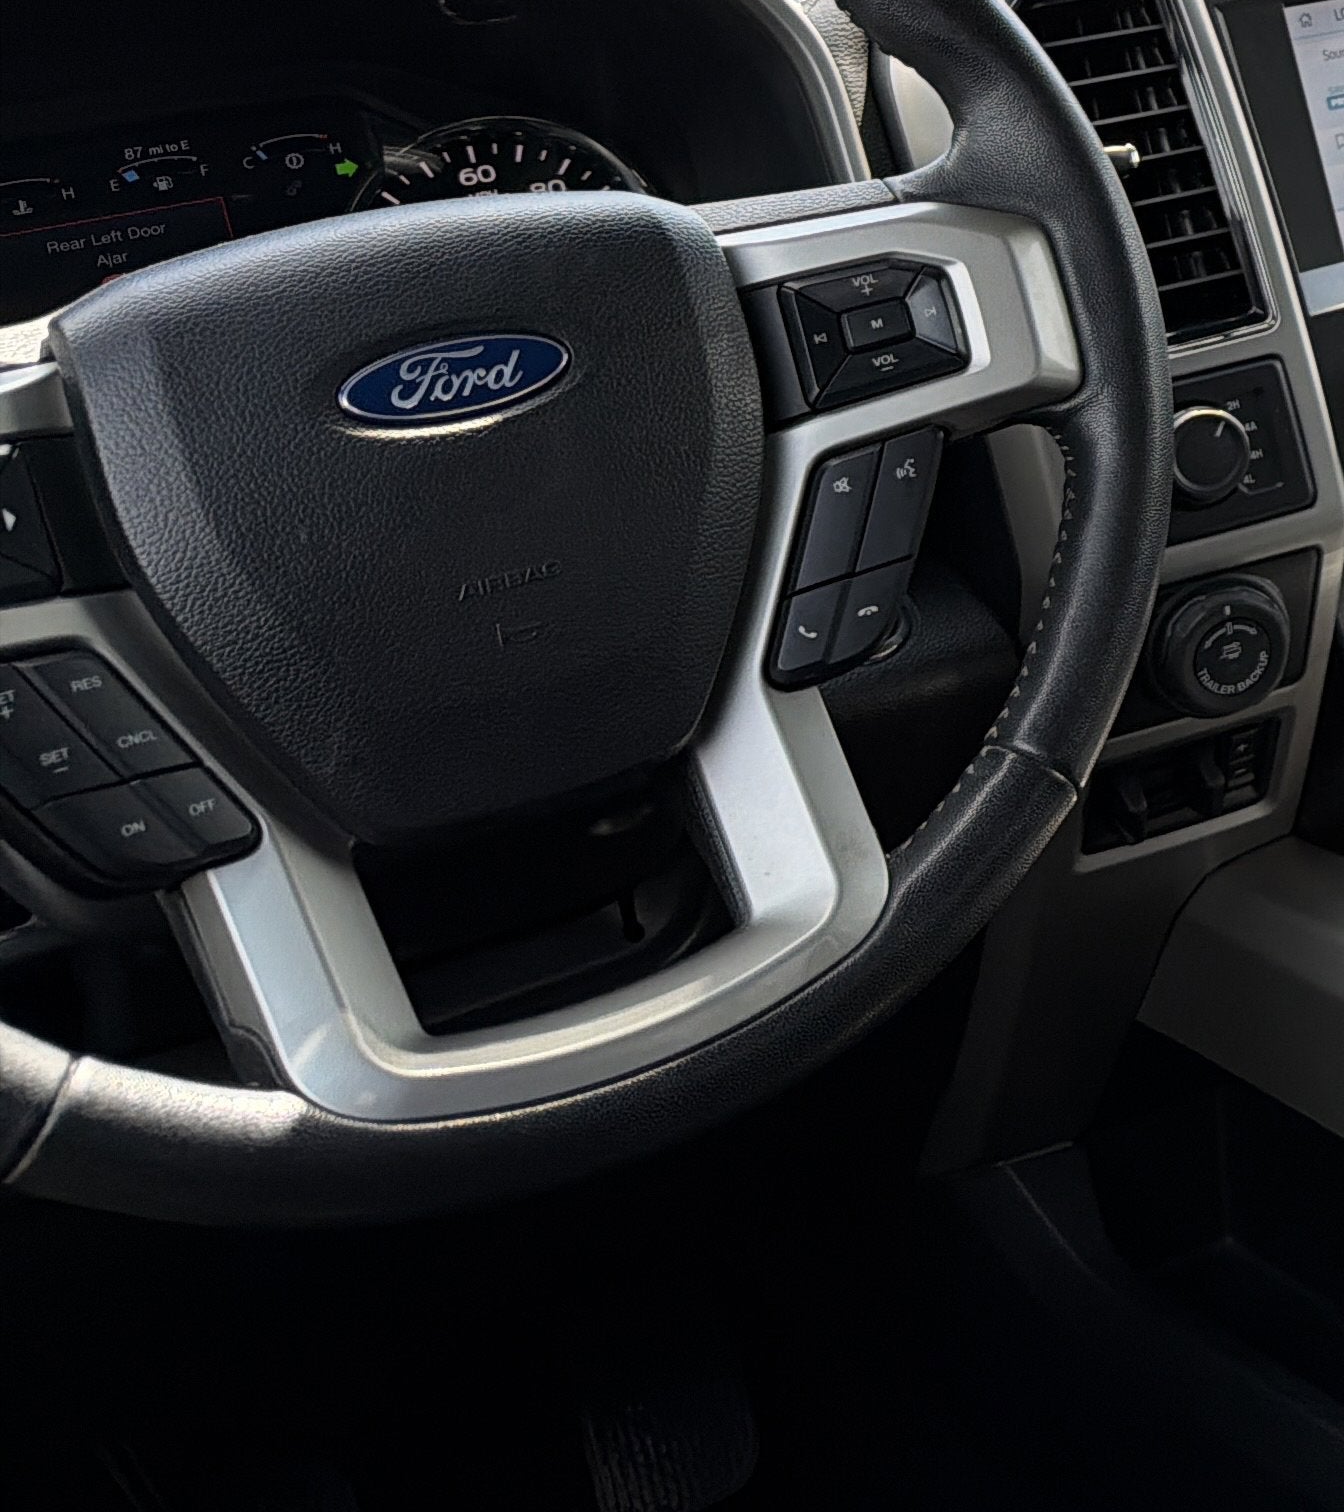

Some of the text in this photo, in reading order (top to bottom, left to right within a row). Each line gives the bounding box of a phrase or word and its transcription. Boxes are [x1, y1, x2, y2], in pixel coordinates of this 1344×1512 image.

[124, 140, 190, 160] 87 mi to E
[200, 164, 208, 176] F
[458, 164, 497, 186] 60
[61, 187, 75, 200] H
[109, 179, 120, 191] E
[46, 223, 166, 254] Rear Left Door
[97, 251, 129, 269] Ajar
[852, 273, 879, 287] VOL
[870, 318, 883, 329] M
[872, 353, 899, 367] VOL
[390, 345, 524, 410] Ford
[1197, 650, 1269, 694] TRAILER BACKUP
[70, 675, 102, 693] RES
[117, 730, 157, 749] CNCL
[39, 747, 69, 766] SET
[188, 799, 216, 817] OFF
[121, 820, 146, 838] ON
